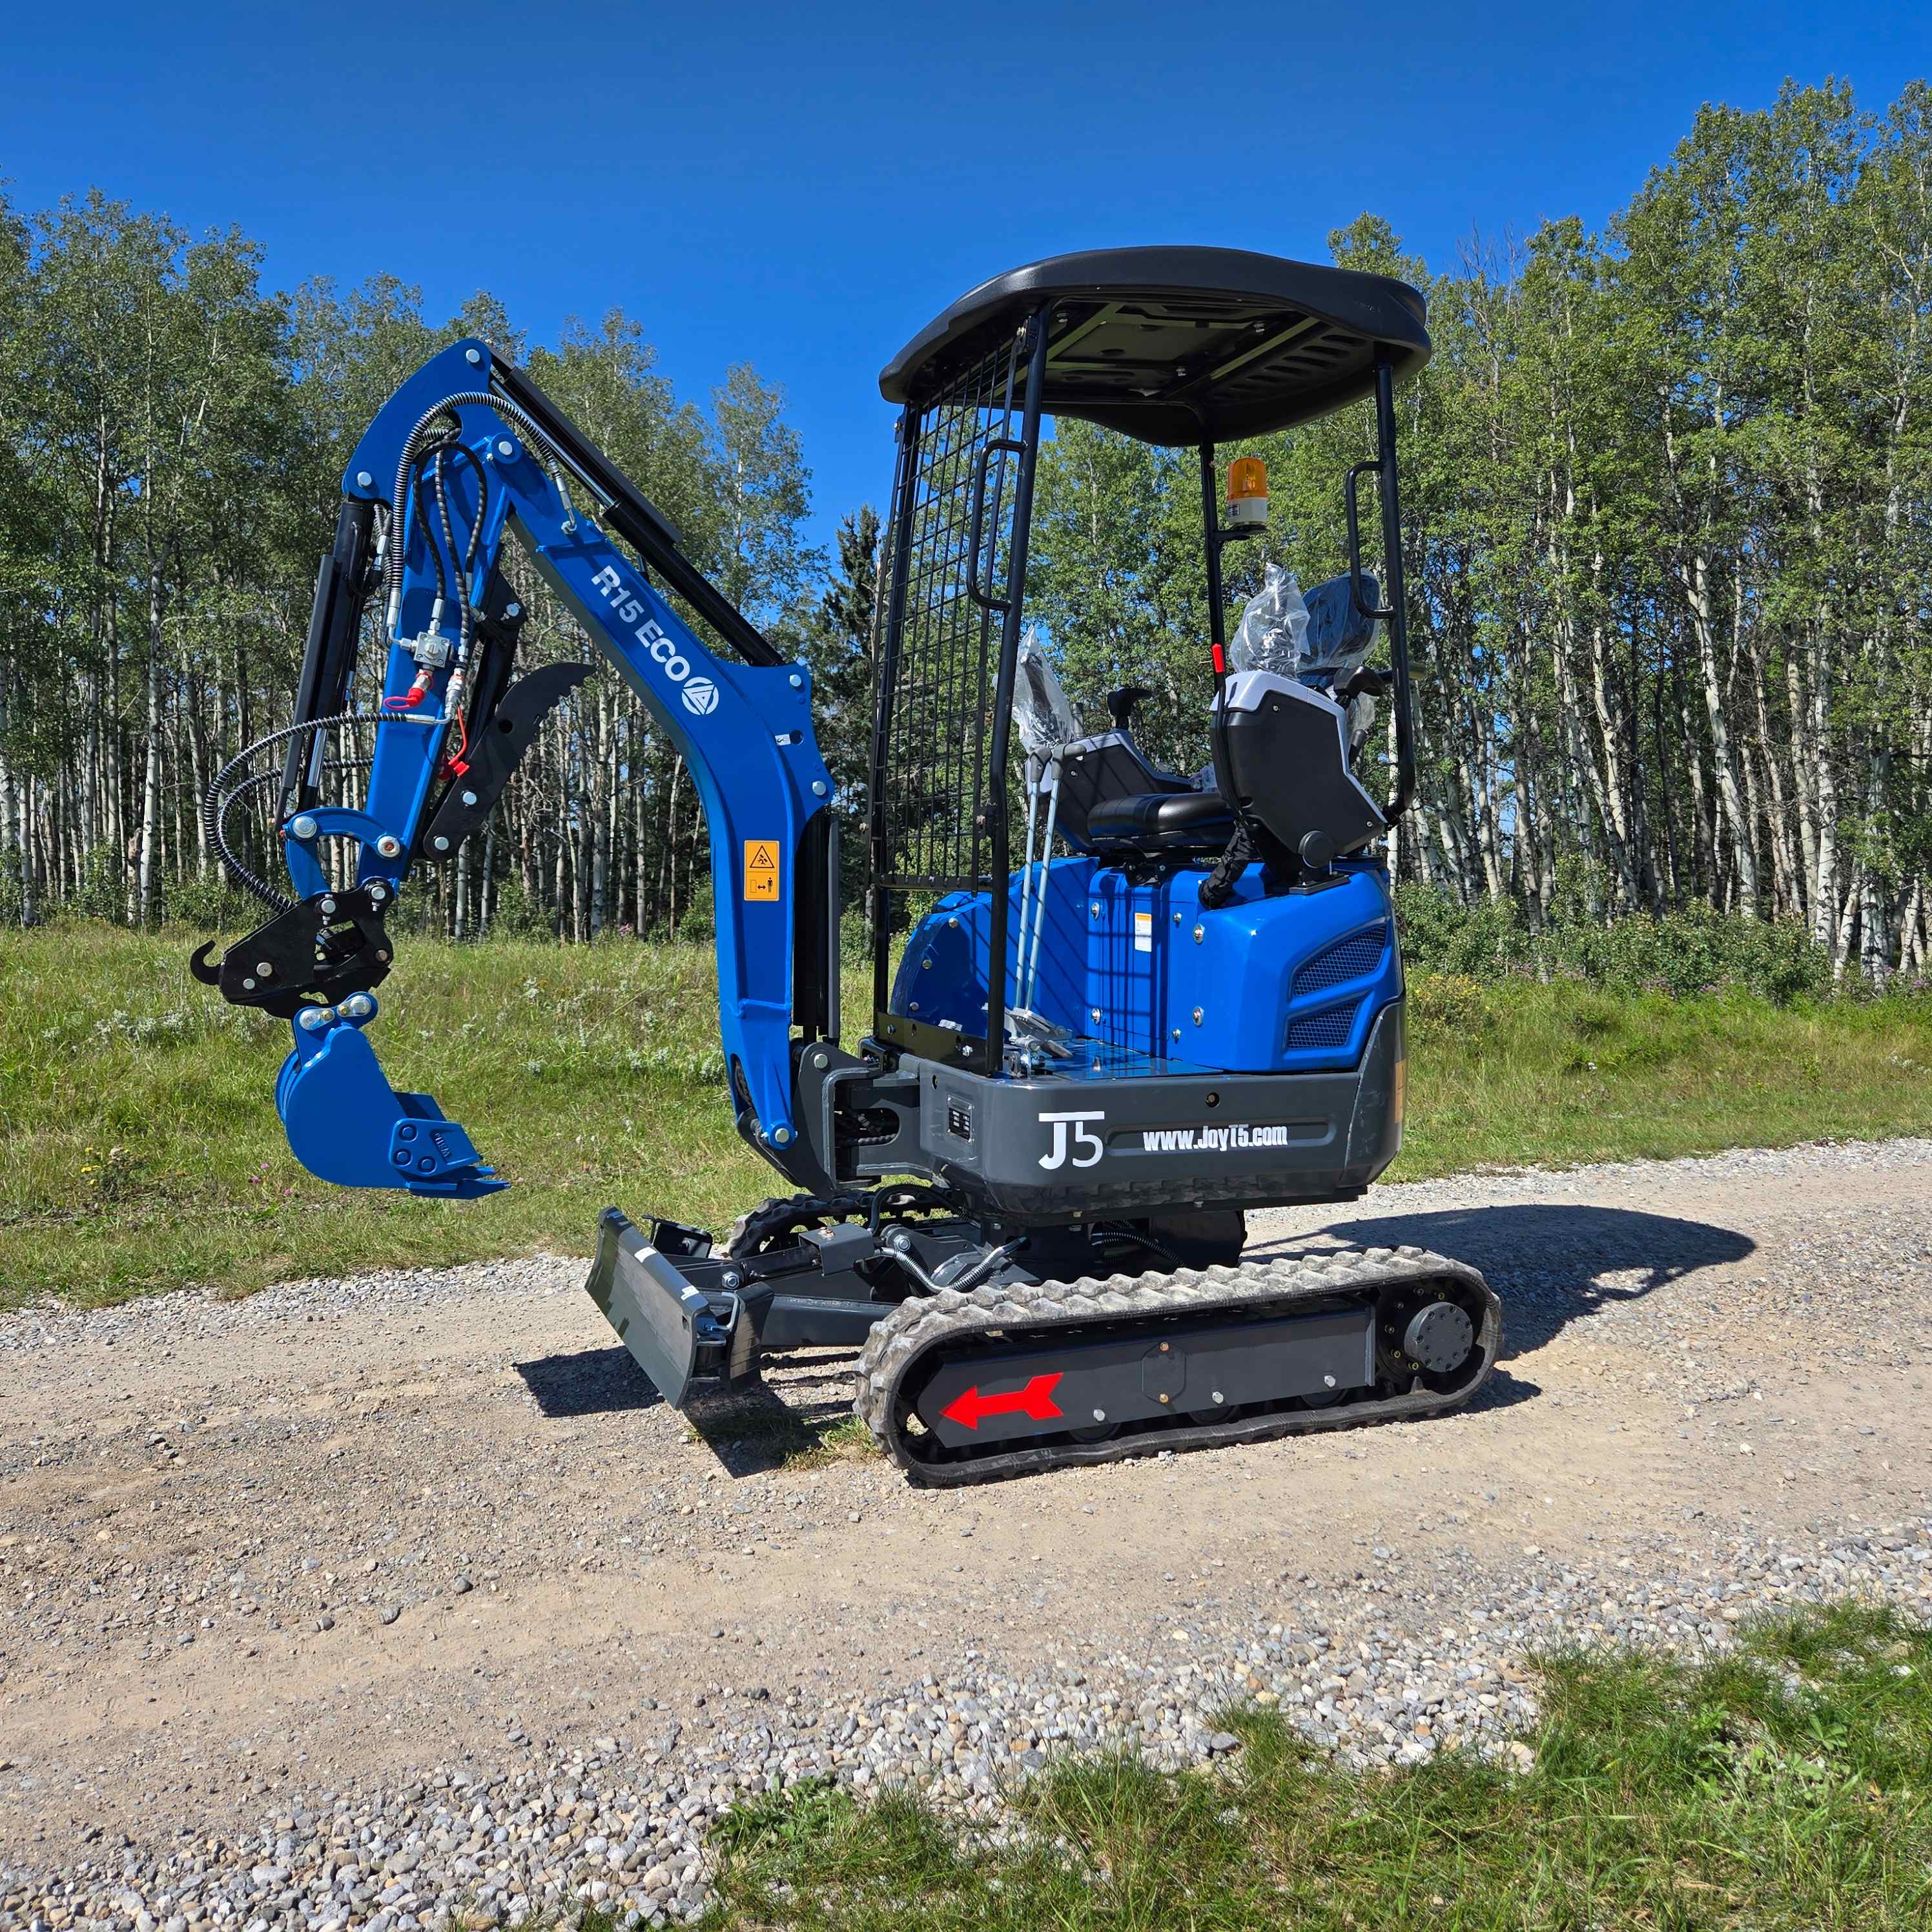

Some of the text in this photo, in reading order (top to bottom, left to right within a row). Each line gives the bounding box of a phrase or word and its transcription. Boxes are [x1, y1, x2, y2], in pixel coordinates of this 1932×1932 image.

[591, 565, 690, 681] R15 ECO
[1038, 1111, 1105, 1170] J5
